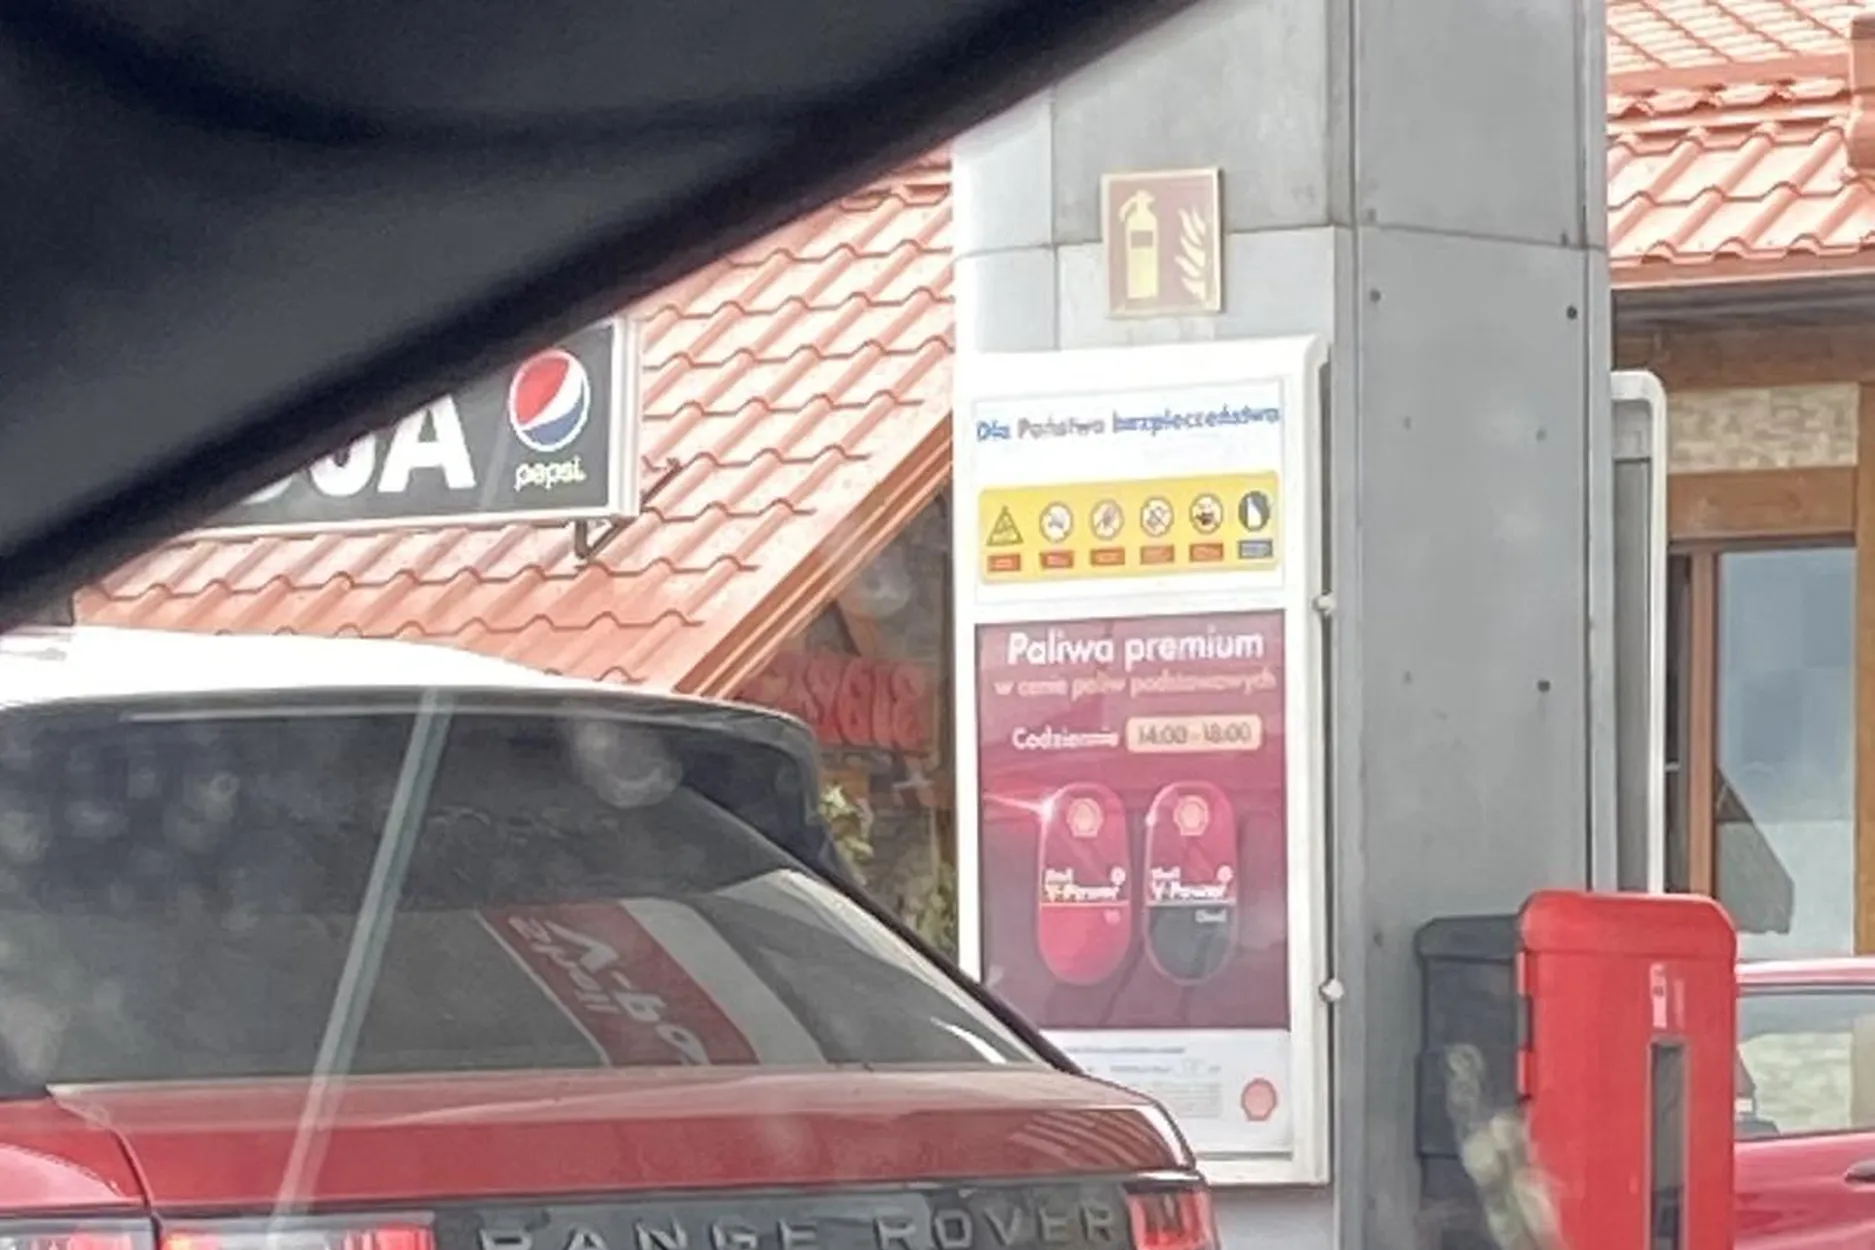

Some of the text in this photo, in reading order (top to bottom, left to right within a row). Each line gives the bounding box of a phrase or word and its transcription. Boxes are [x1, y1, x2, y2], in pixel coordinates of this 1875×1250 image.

[514, 455, 587, 491] pepsi
[1007, 624, 1264, 672] Paliwa premium
